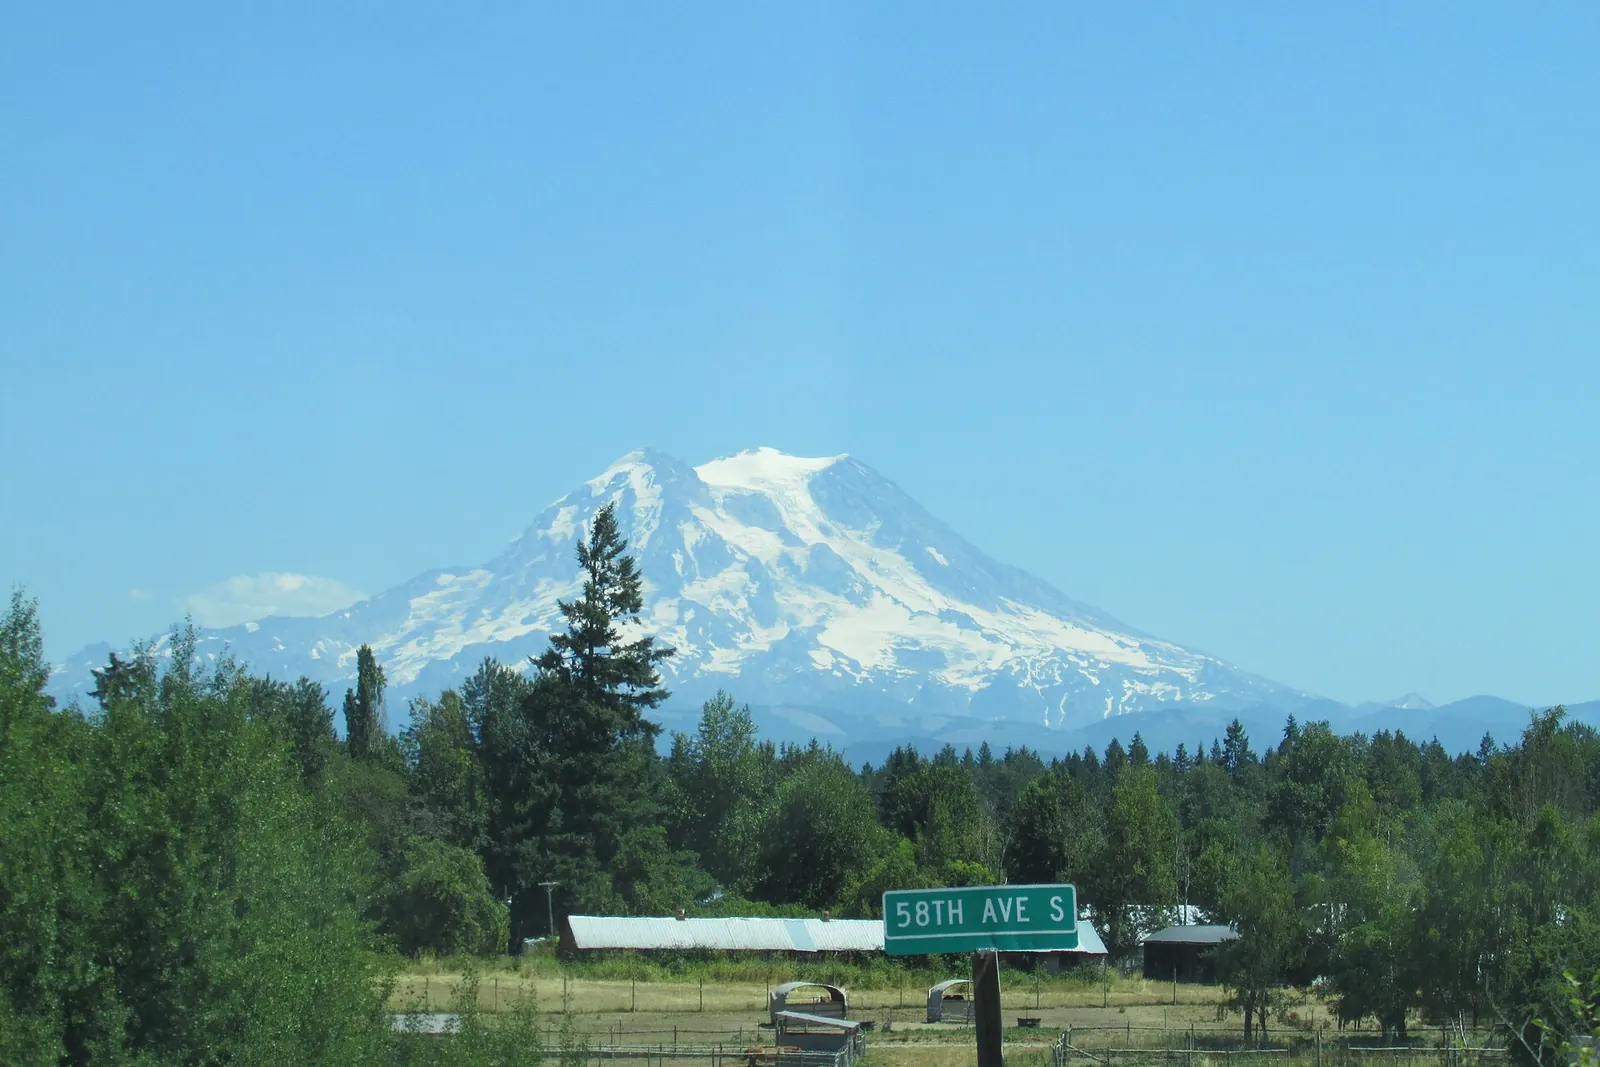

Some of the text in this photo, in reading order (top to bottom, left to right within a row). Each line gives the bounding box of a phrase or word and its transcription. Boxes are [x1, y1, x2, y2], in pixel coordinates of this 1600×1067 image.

[896, 895, 1065, 928] 58TH AVE S
